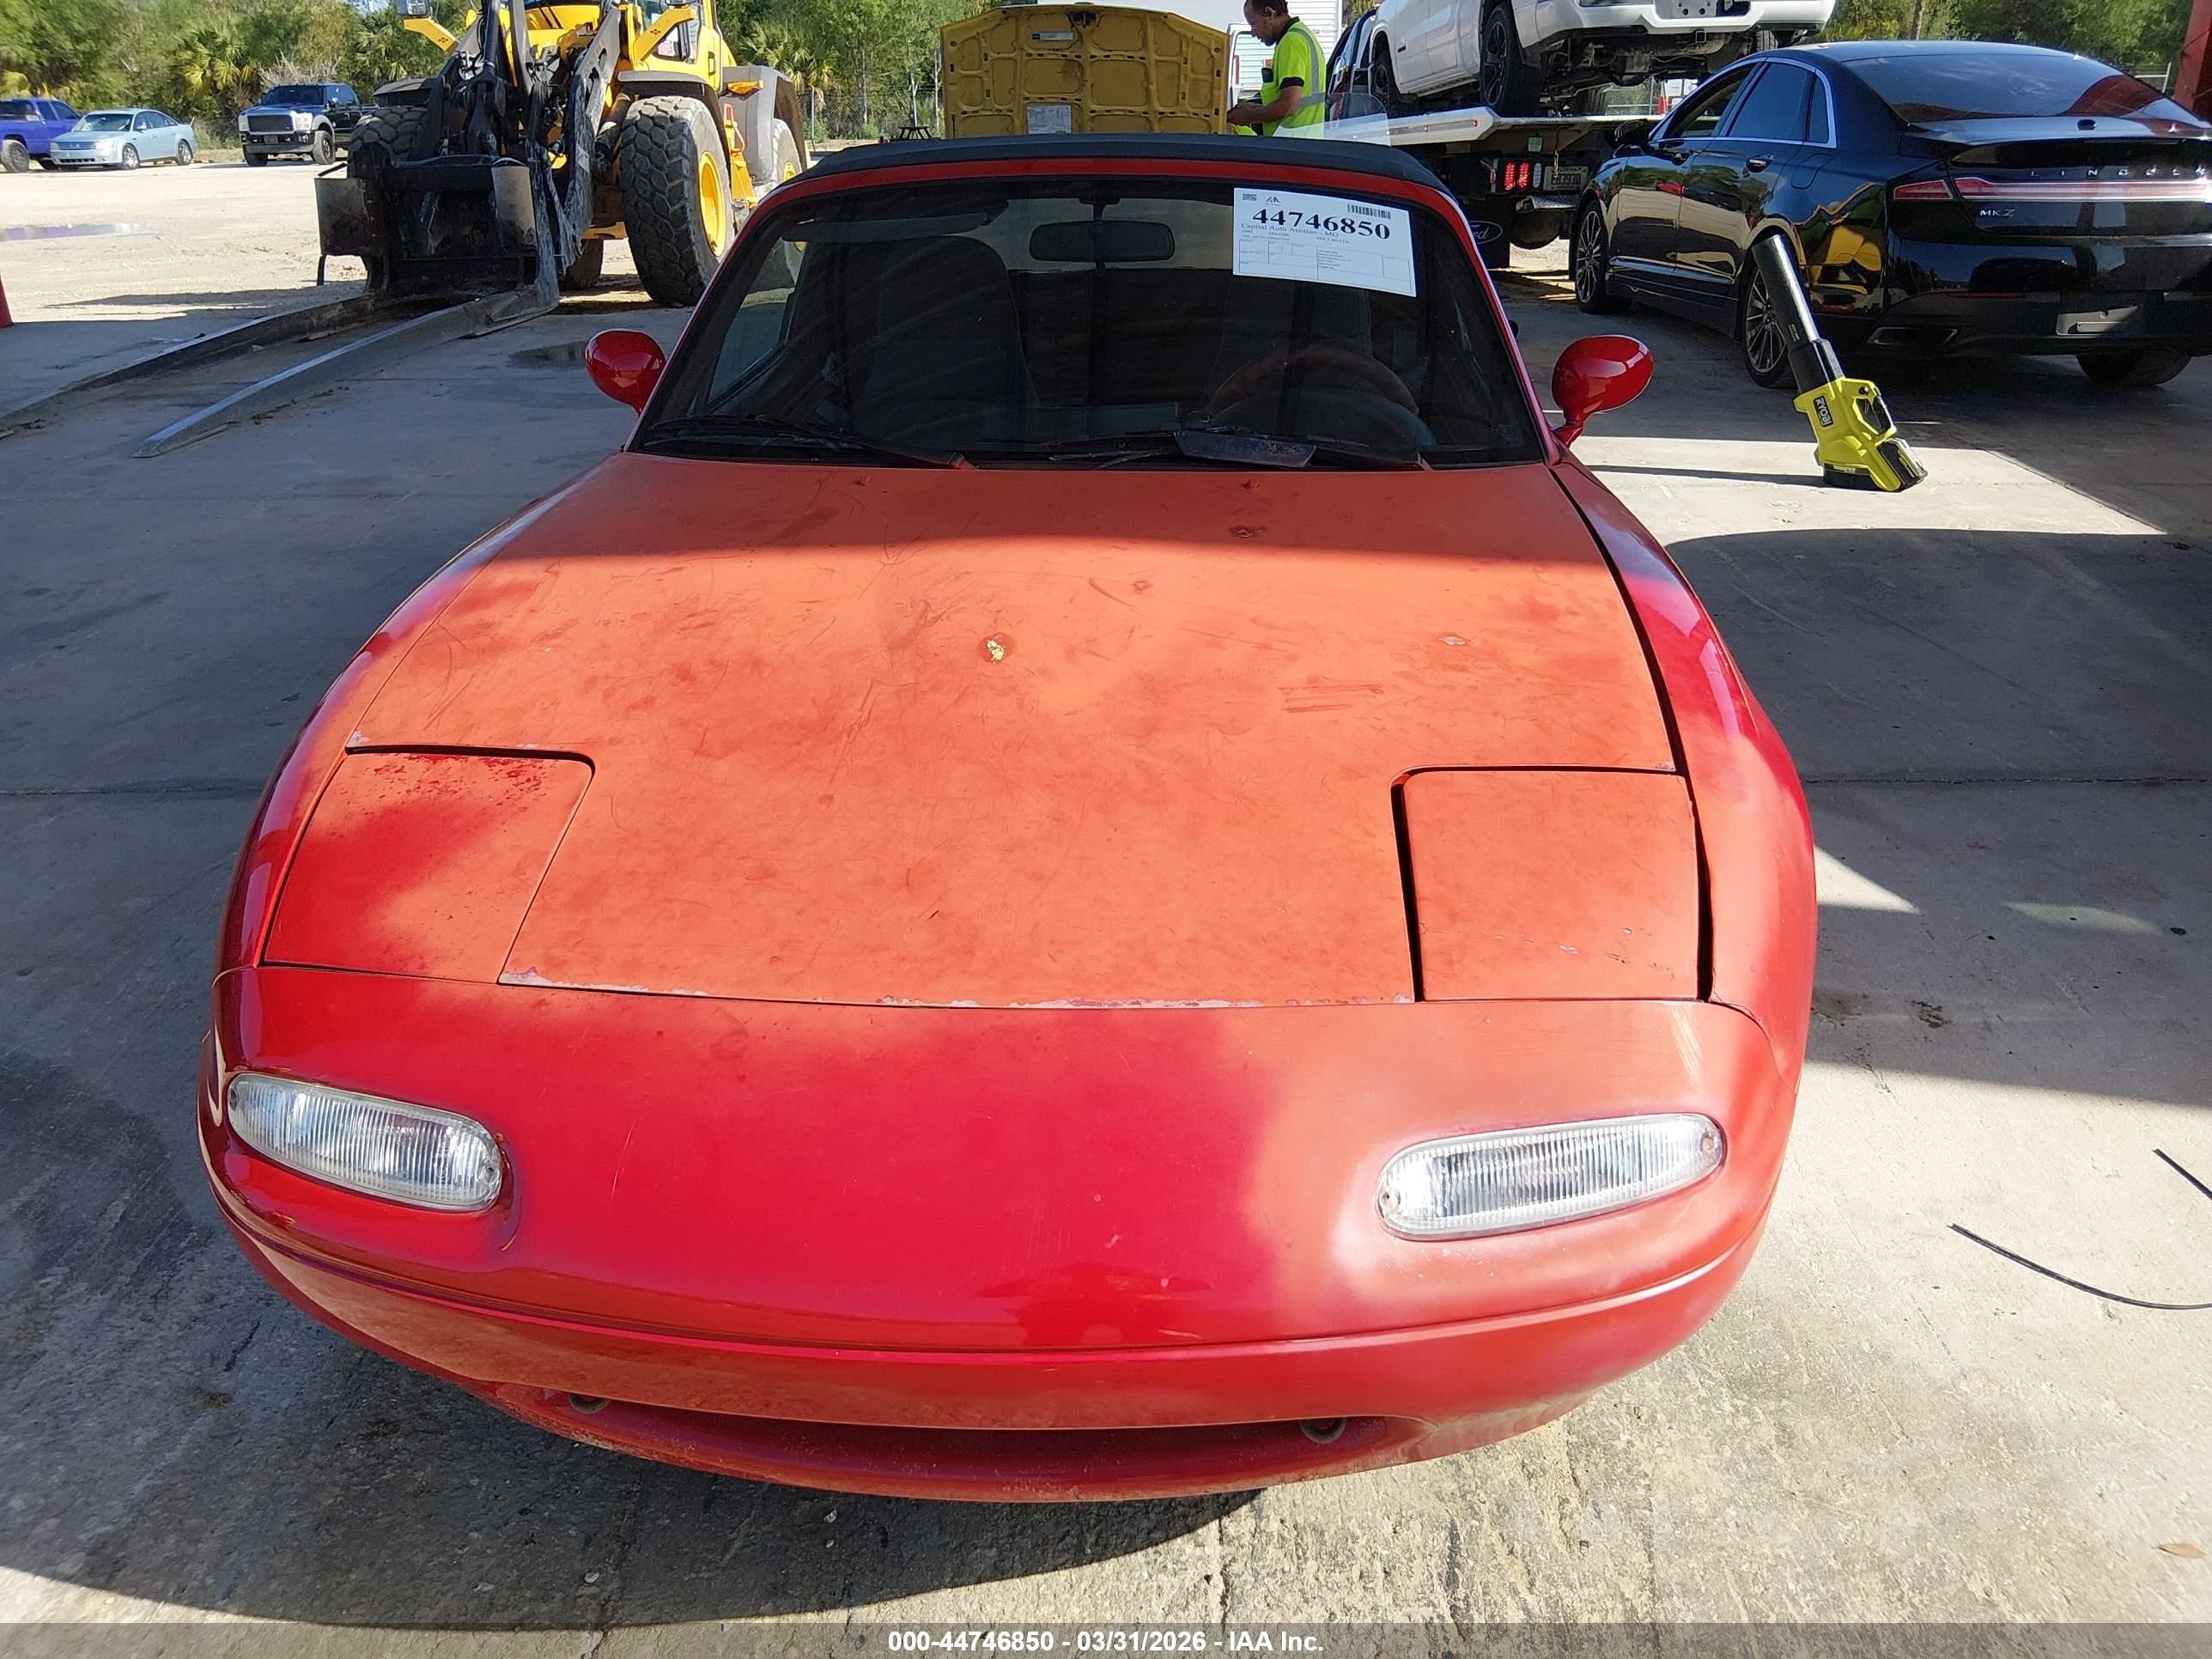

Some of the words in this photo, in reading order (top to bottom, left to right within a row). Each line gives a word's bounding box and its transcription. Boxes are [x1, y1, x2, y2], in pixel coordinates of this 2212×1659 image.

[1252, 208, 1390, 240] 44746850
[1979, 209, 2015, 217] MKZ
[1815, 397, 1832, 425] RYOBI
